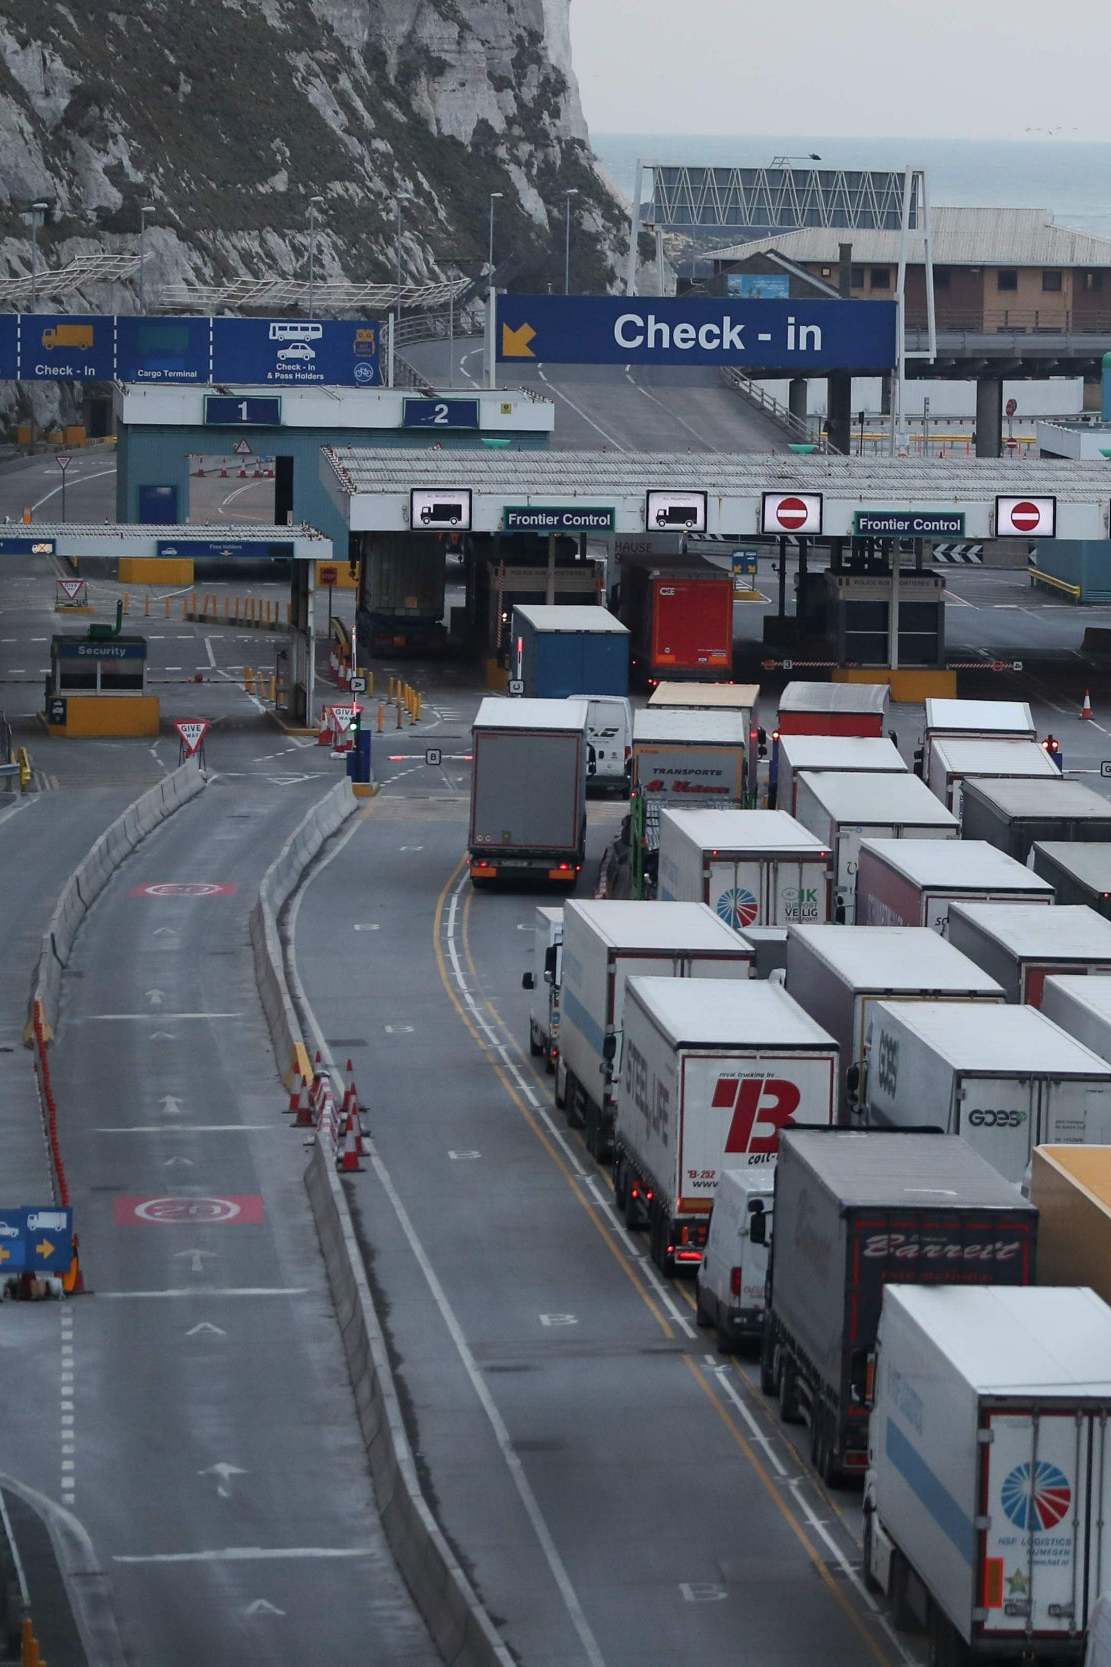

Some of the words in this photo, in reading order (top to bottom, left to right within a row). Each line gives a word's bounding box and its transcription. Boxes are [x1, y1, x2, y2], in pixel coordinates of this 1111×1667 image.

[613, 313, 745, 350] Check
[786, 317, 823, 351] in
[35, 364, 73, 376] Check
[84, 365, 96, 376] In
[276, 363, 299, 371] Check
[306, 363, 316, 371] In
[137, 369, 162, 380] Cargo
[164, 370, 197, 379] Terminal
[275, 371, 292, 380] Pass
[294, 372, 324, 380] Holders
[238, 402, 248, 420] 1
[435, 405, 448, 423] 2
[508, 513, 560, 526] Frontier
[562, 513, 611, 526] Control
[859, 518, 910, 530] Frontier
[913, 518, 961, 531] Control
[78, 646, 126, 657] Security
[181, 724, 201, 732] GIVE
[1105, 765, 1111, 773] G
[748, 1152, 779, 1165] coil-
